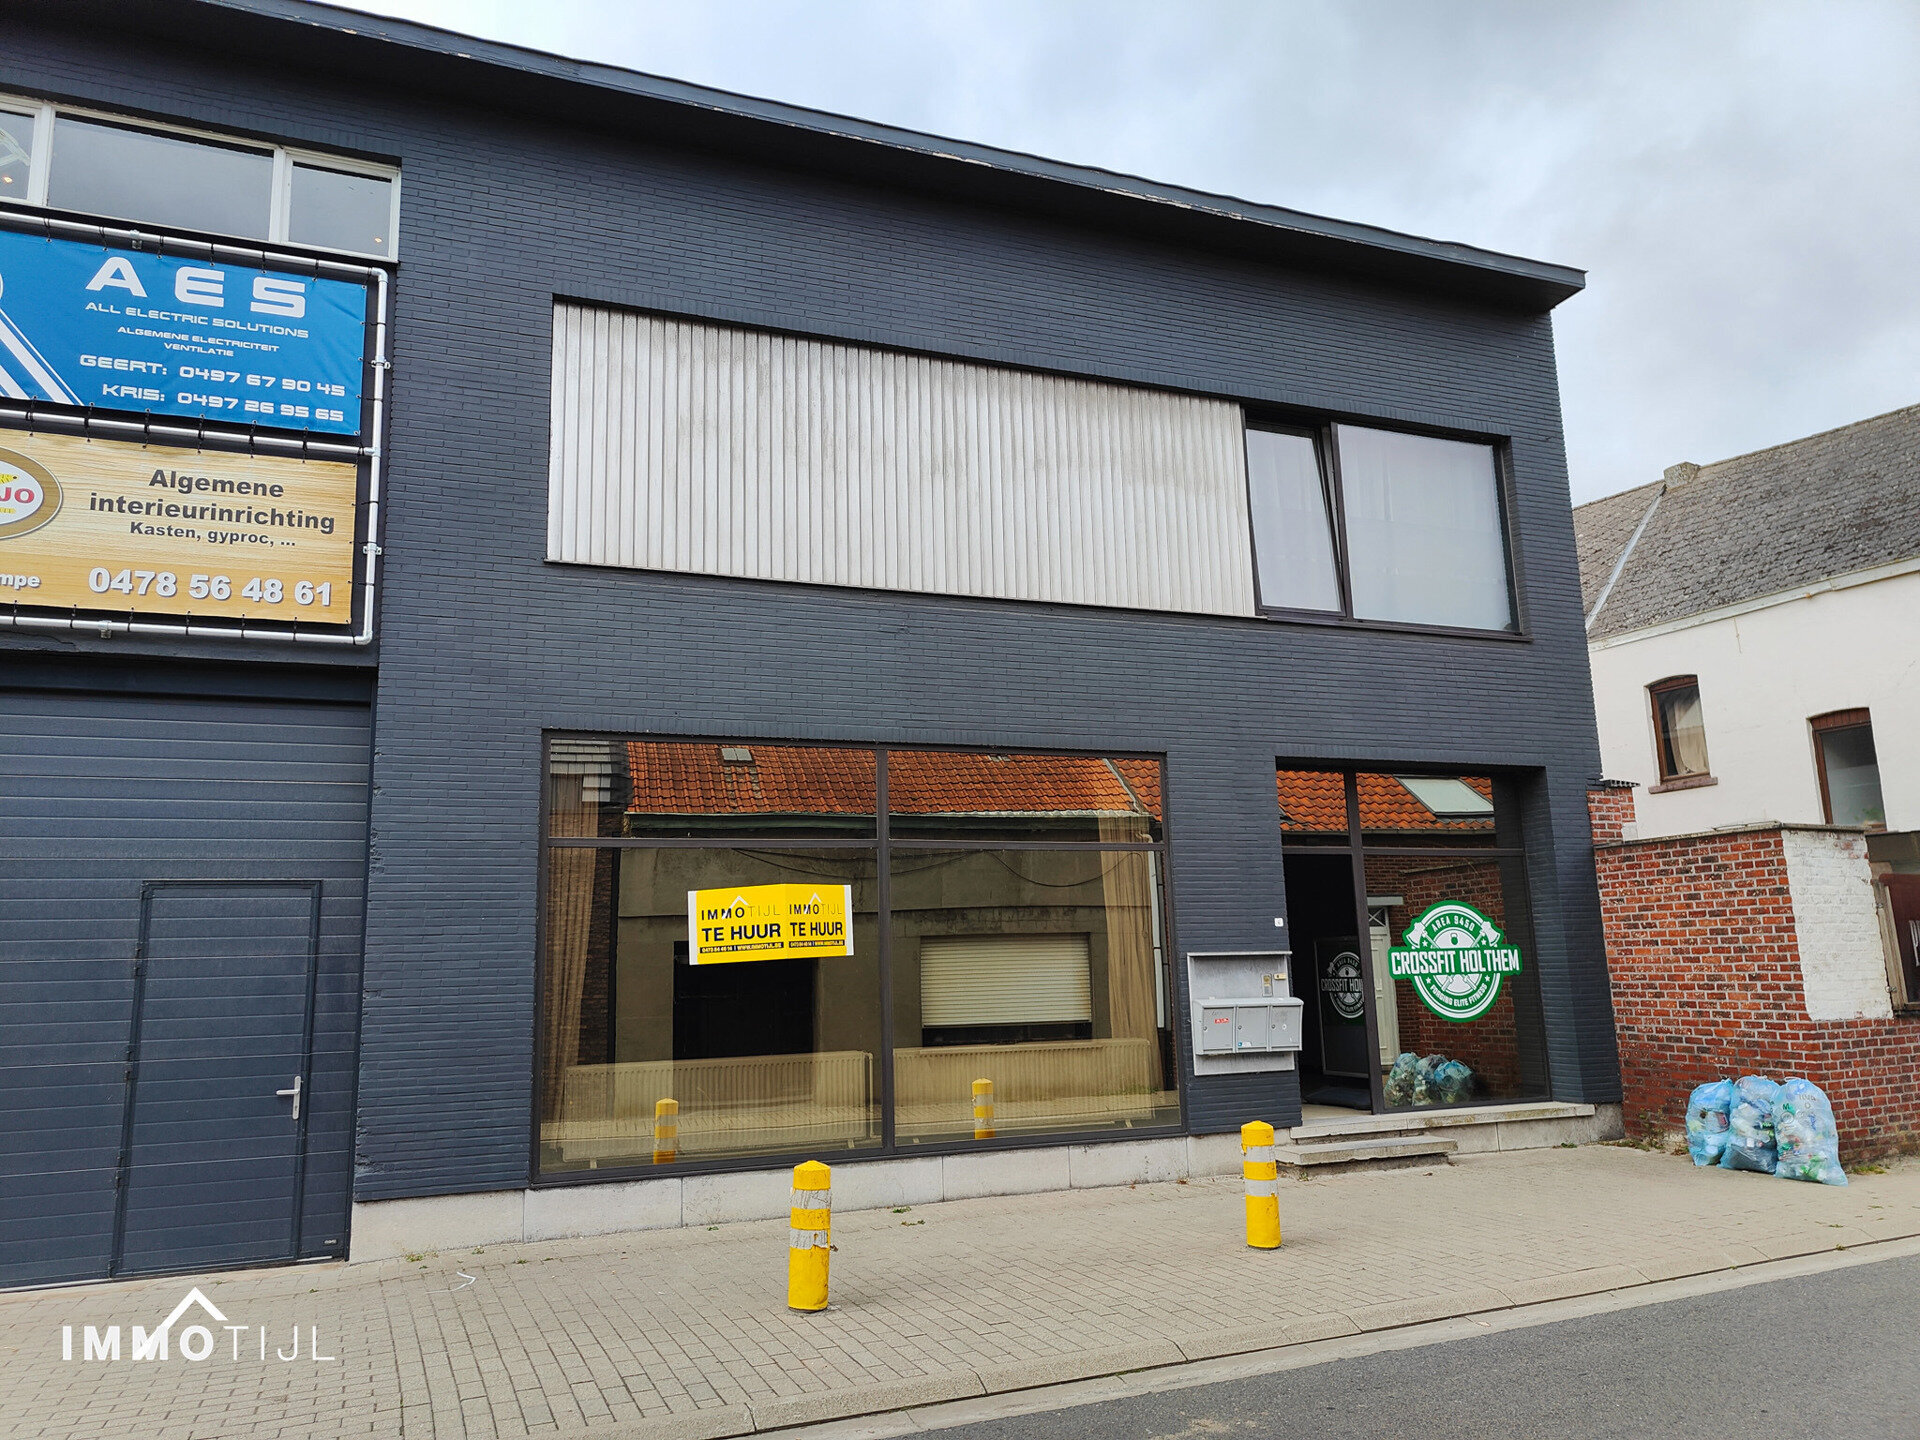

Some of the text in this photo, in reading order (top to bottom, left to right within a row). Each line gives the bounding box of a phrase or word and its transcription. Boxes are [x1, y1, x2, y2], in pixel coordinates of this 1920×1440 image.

[85, 302, 309, 339] ALL ELECTRIC SOLUTIONS
[117, 326, 280, 352] ALGEMENE ELECTRICITEIT
[164, 342, 234, 357] VENTILATIE
[80, 354, 345, 397] GEERT: 0497 67 90 45
[102, 384, 344, 422] KRIS: 0497 26 95 65
[149, 469, 285, 498] Algemene
[89, 492, 336, 535] interieurinrichting
[129, 521, 201, 541] Kasten,
[207, 530, 274, 547] gyproc,
[88, 567, 332, 606] 0478 56 48 61
[701, 923, 781, 942] TE HUUR
[789, 921, 843, 937] TE HUUR
[1431, 916, 1451, 933] AREA
[1391, 949, 1520, 975] CROSSFIT HOLTHEM
